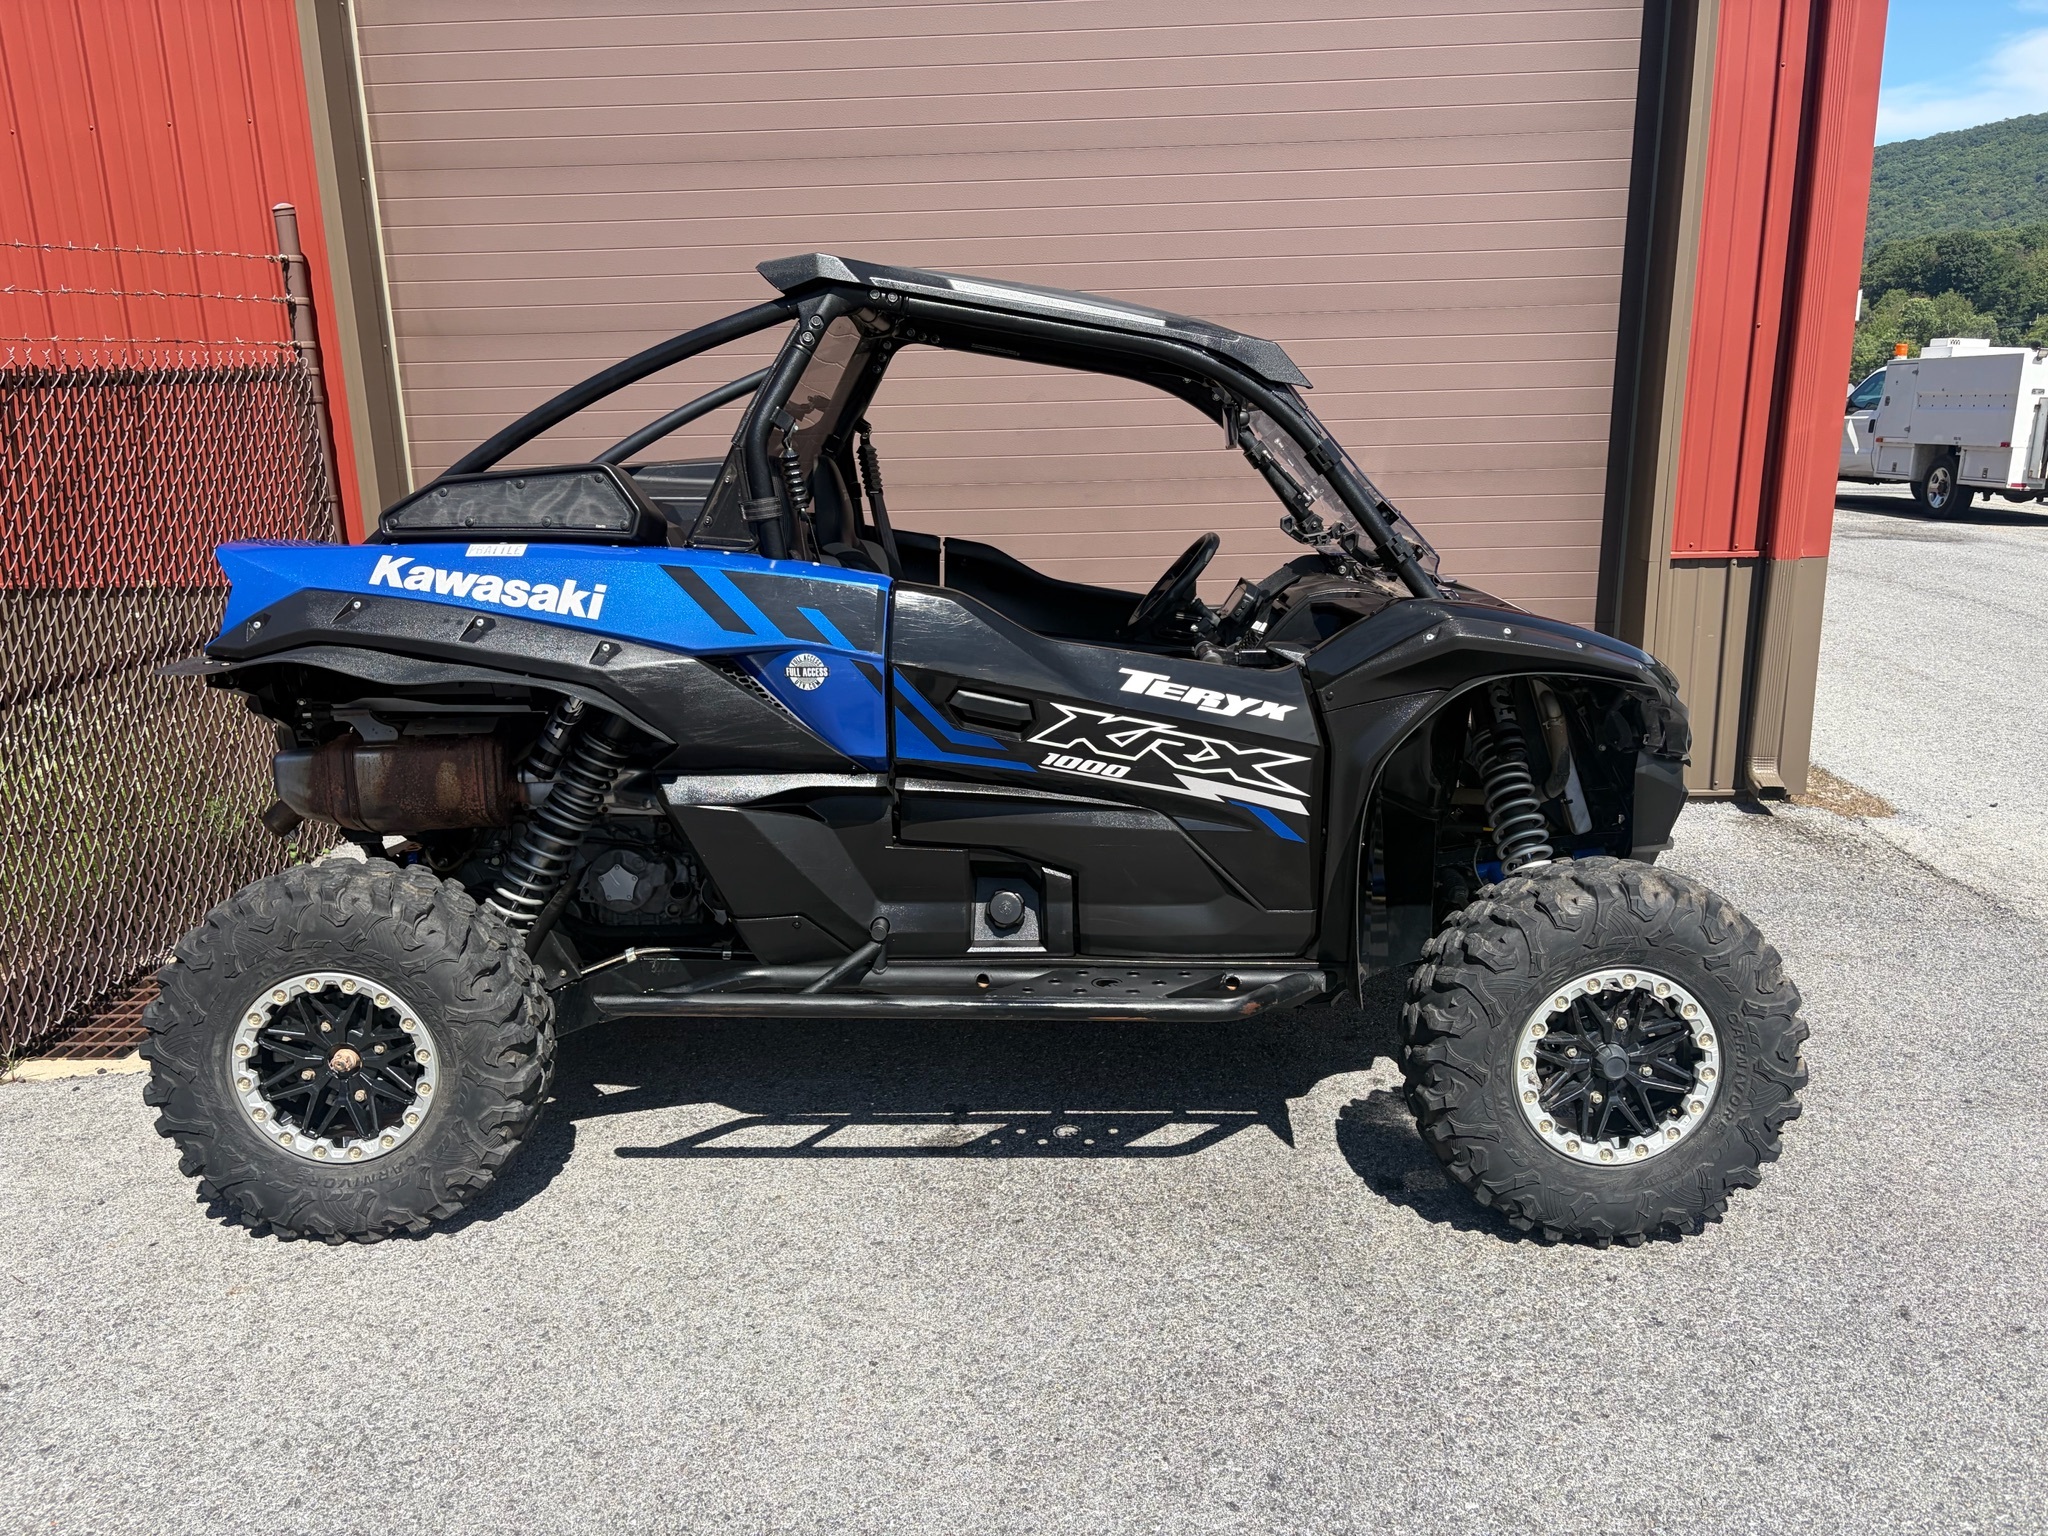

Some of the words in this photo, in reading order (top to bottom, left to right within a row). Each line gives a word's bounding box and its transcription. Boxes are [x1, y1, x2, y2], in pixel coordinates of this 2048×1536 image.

[368, 555, 608, 620] Kawasaki
[786, 667, 801, 677] FULL
[802, 667, 828, 677] ACCESS
[1118, 667, 1298, 722] TERYX
[1027, 702, 1311, 798] KRX
[1041, 752, 1132, 779] 1000
[1715, 1012, 1748, 1132] CARNIVORE
[292, 1155, 417, 1188] CARNIVORE
